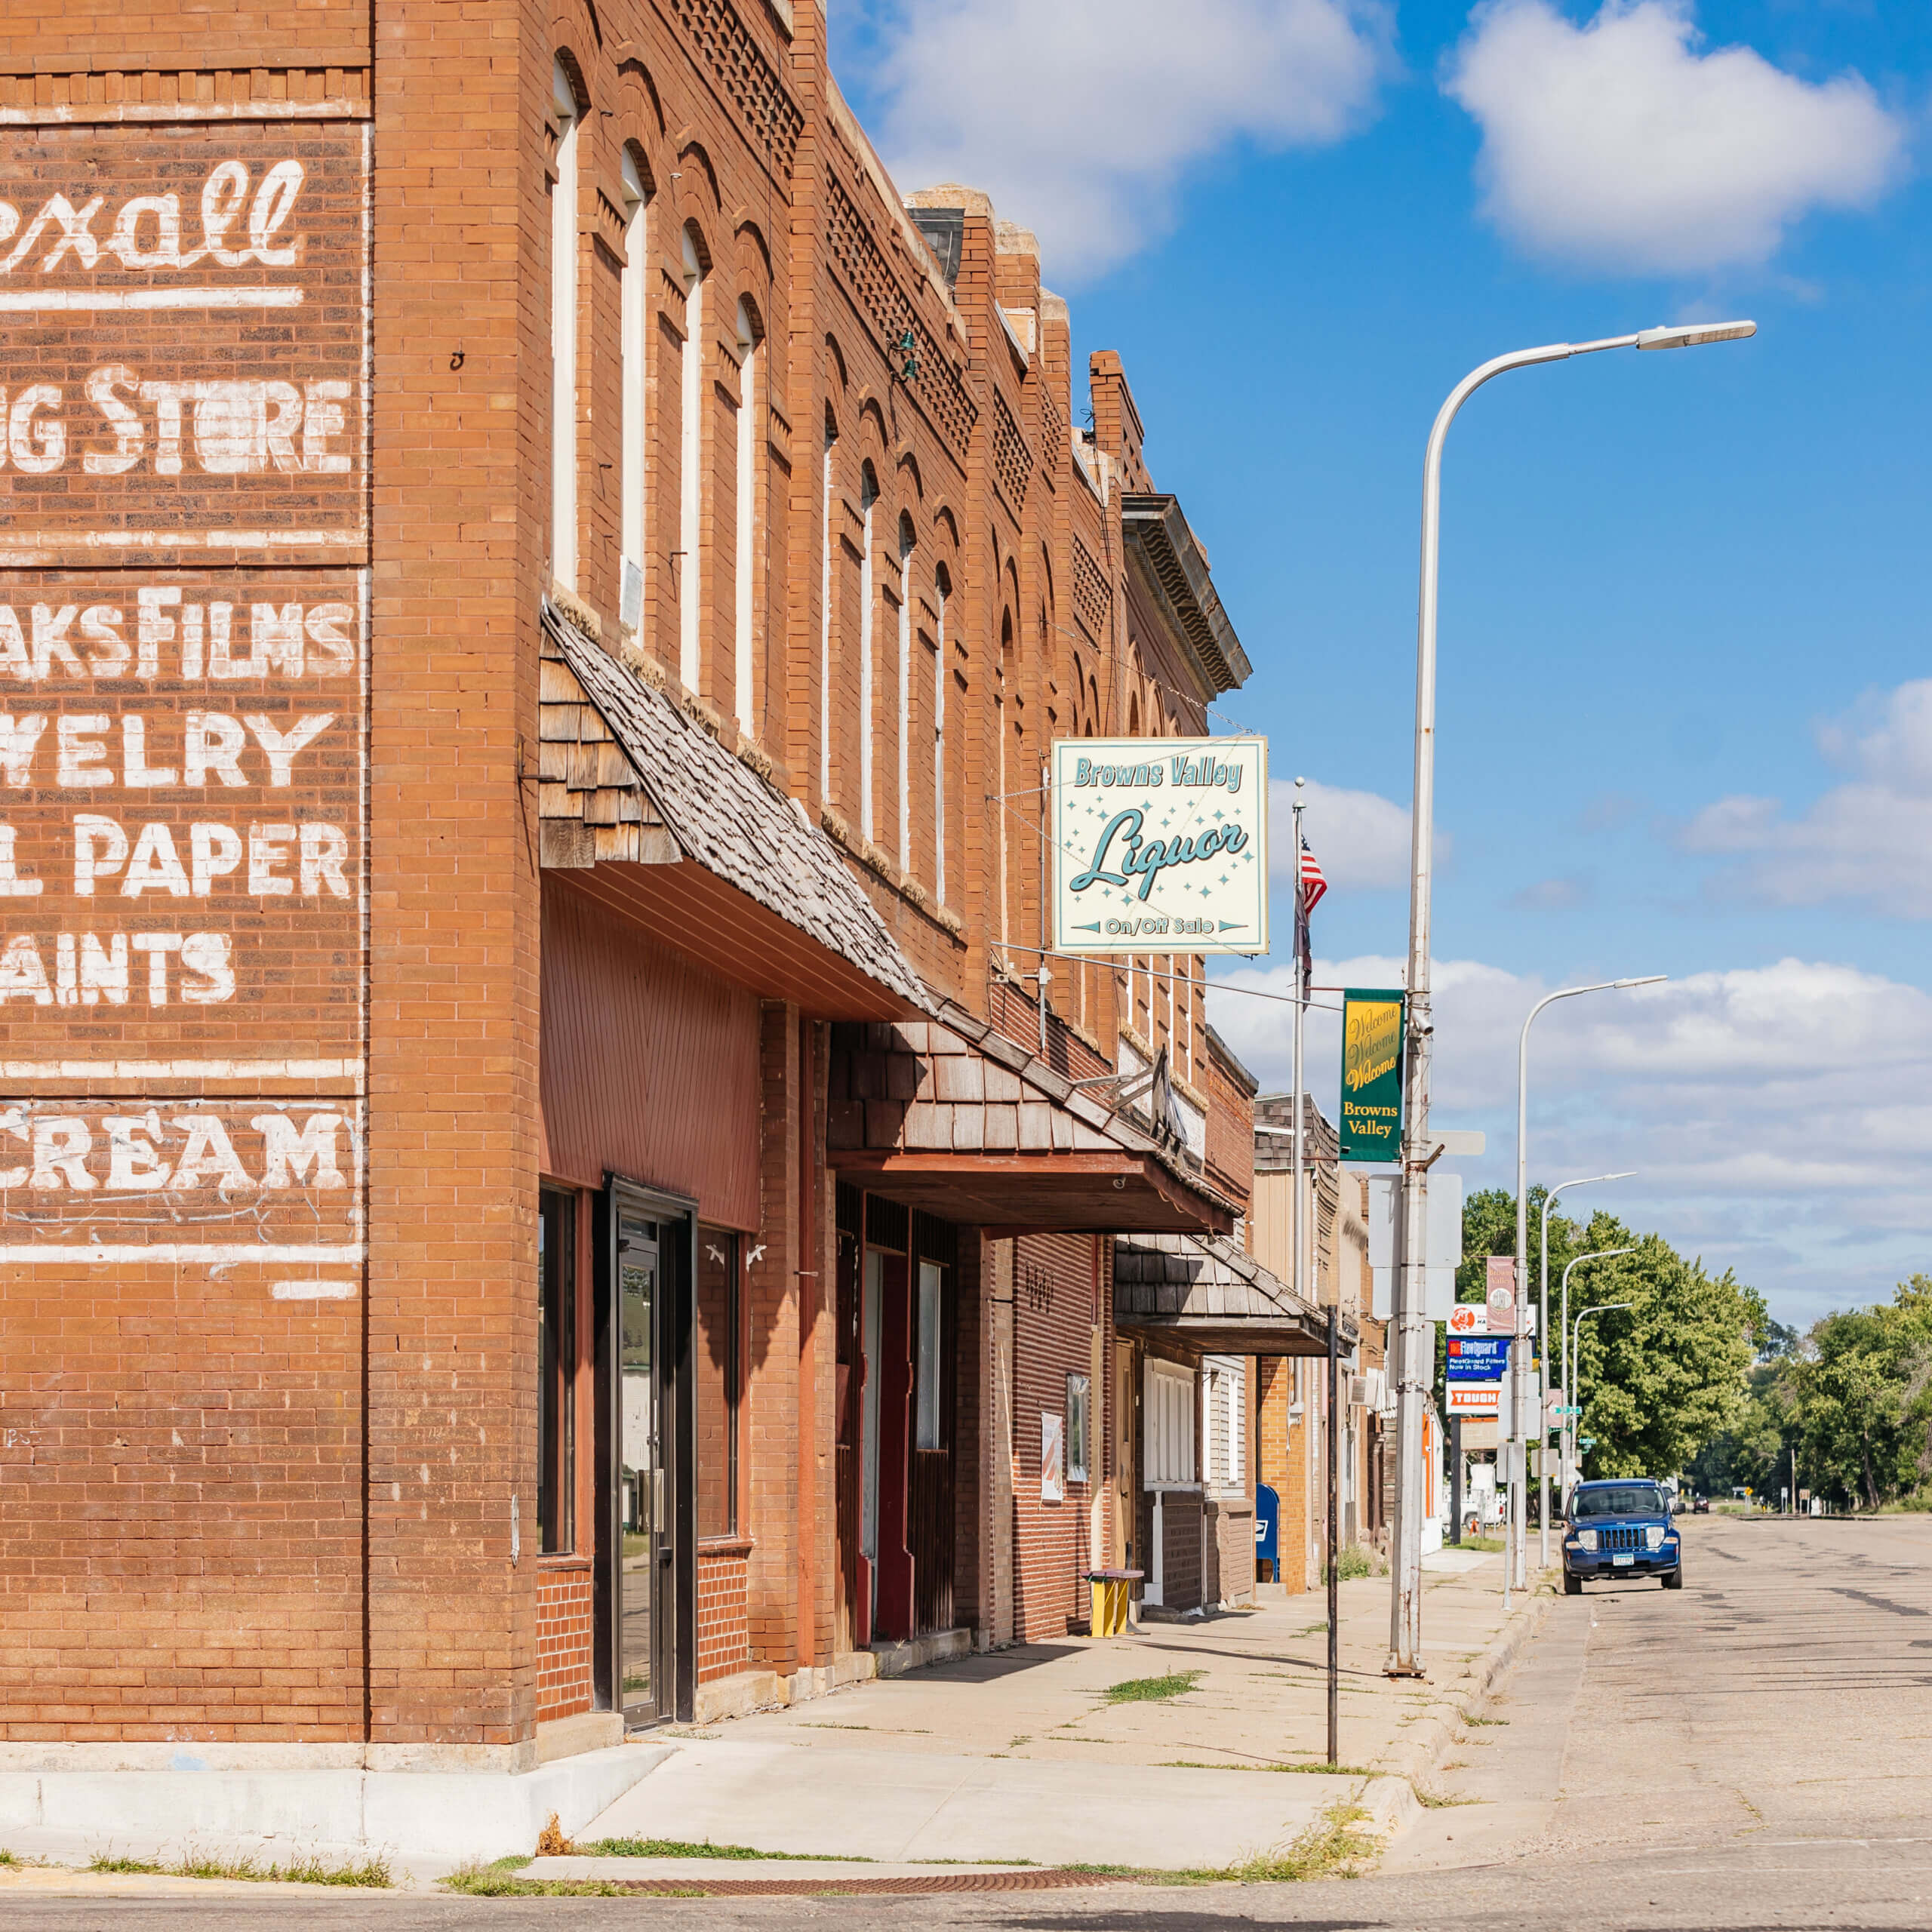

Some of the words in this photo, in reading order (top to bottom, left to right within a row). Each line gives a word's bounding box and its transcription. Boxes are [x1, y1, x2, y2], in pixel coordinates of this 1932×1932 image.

[137, 586, 355, 681] FILMS
[1074, 755, 1163, 788] Browns
[1171, 755, 1244, 794] Valley
[73, 814, 351, 898] PAPER
[1069, 808, 1248, 901] Liquor
[1104, 918, 1168, 936] On/Off
[1173, 918, 1215, 934] Sale
[1348, 1006, 1397, 1040] Welcome
[1347, 1030, 1396, 1066] Welcome
[1346, 1057, 1396, 1092] Welcome
[1343, 1102, 1398, 1116] Browns
[1348, 1120, 1392, 1139] Valley
